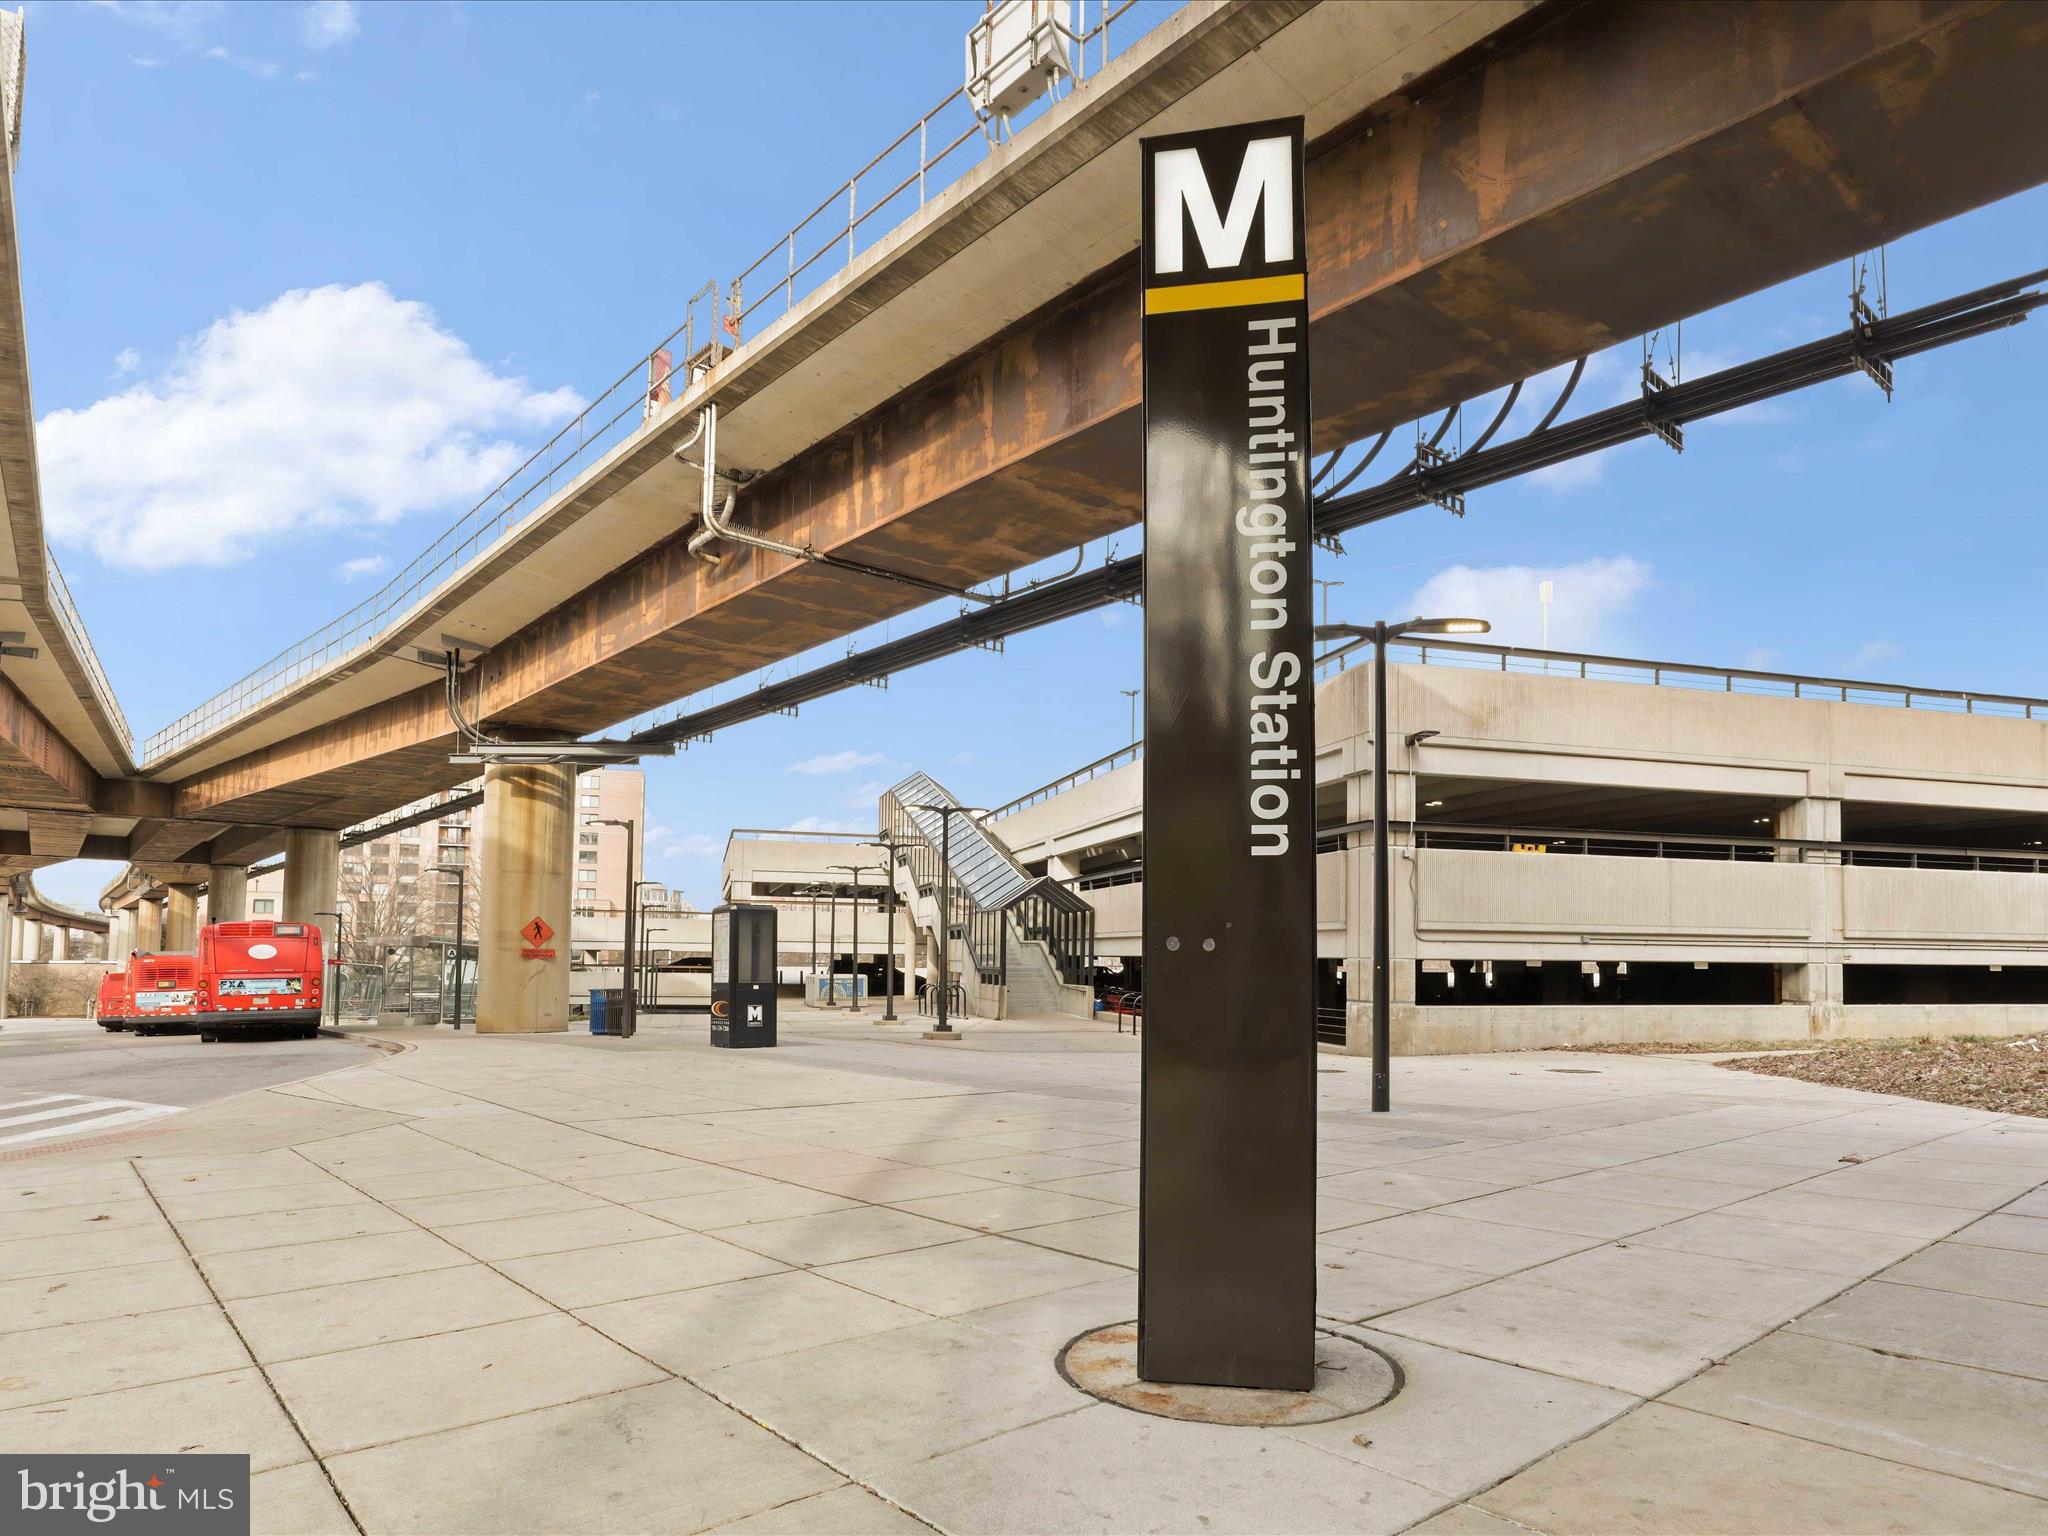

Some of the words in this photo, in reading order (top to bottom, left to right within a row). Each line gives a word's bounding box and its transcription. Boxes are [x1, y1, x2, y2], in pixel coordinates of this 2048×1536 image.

[1154, 136, 1294, 274] M
[1236, 317, 1298, 630] Huntington
[1249, 651, 1301, 856] Station
[748, 1006, 763, 1021] M
